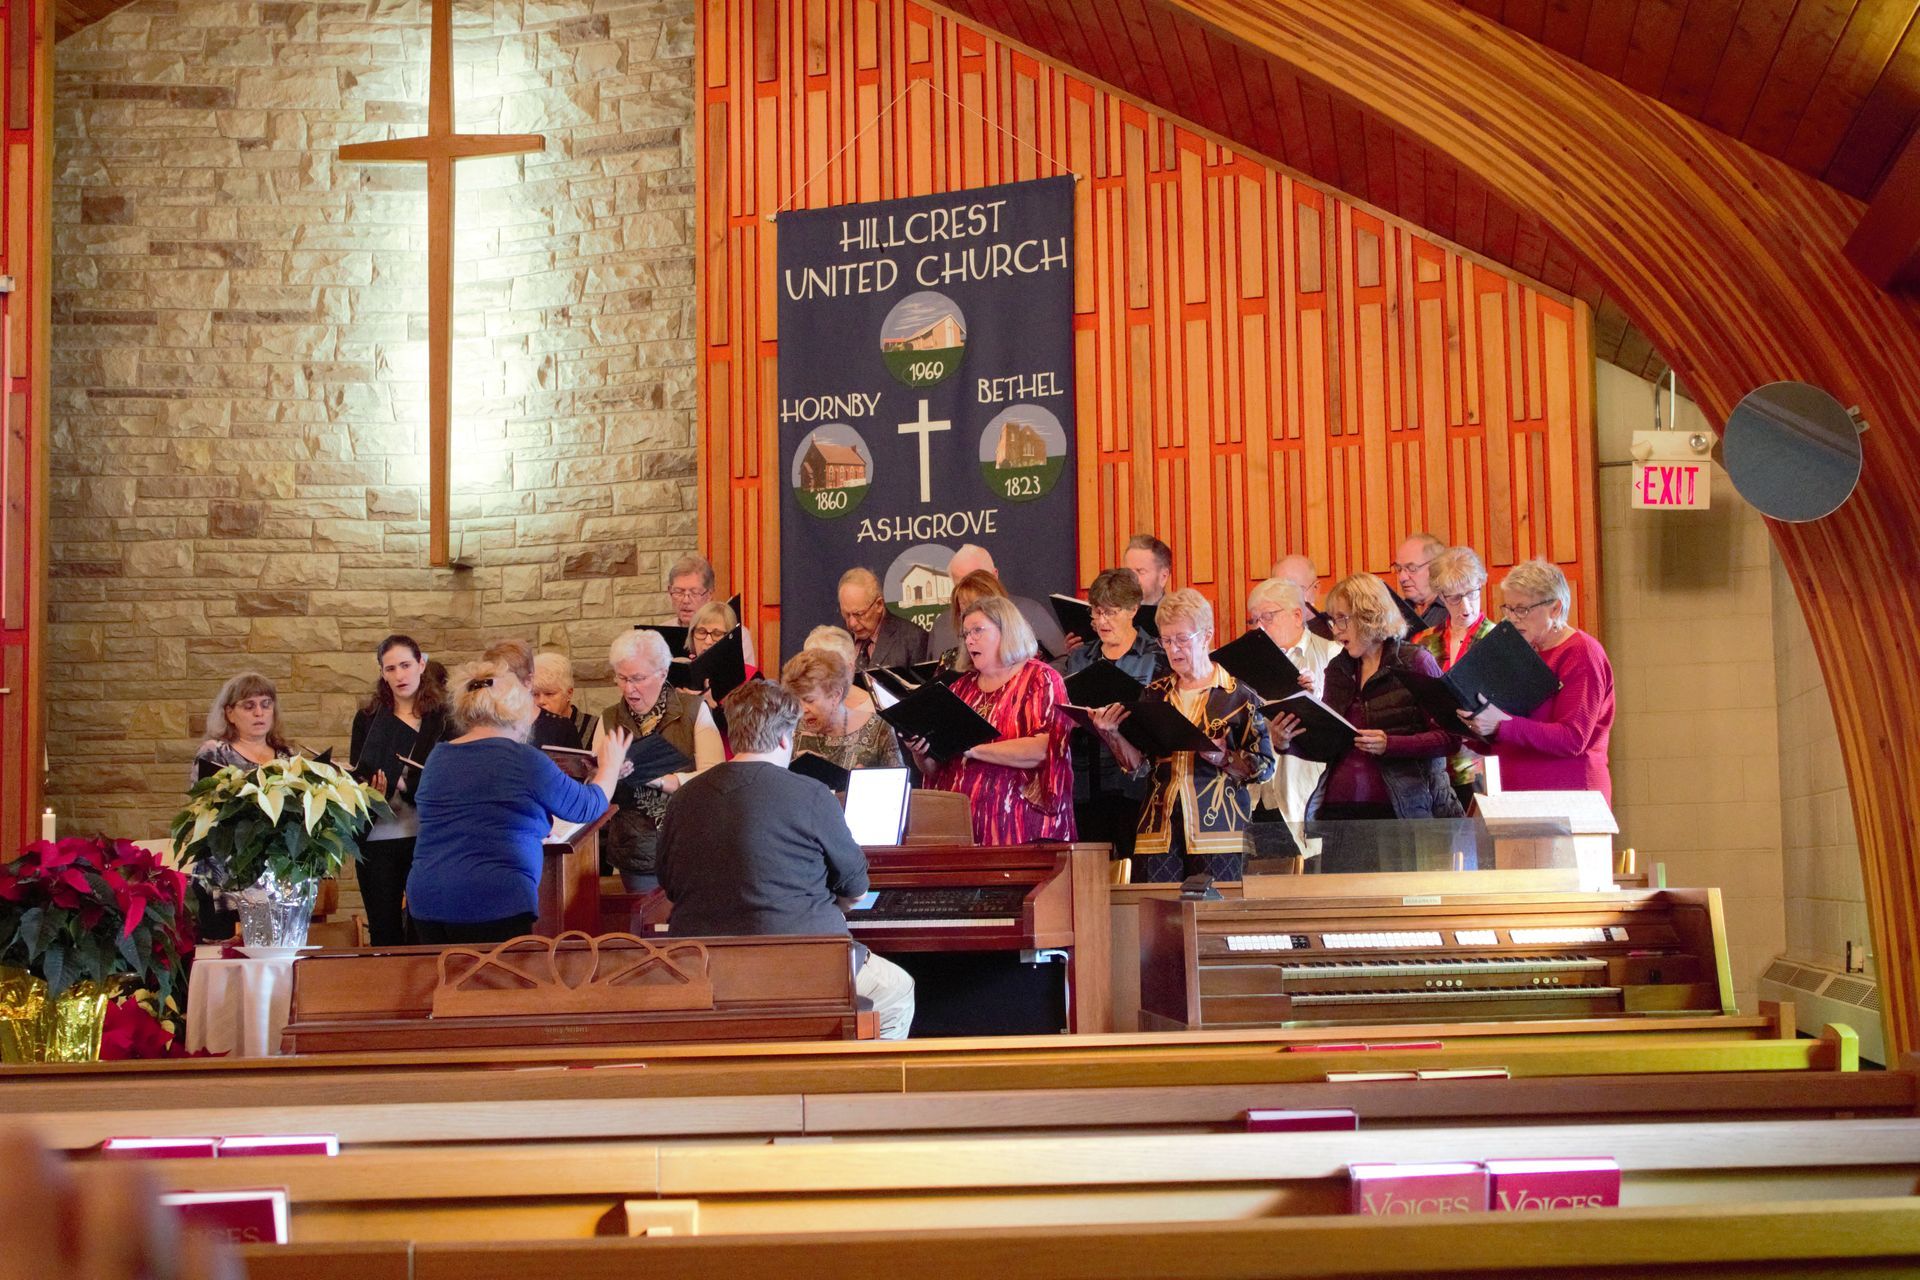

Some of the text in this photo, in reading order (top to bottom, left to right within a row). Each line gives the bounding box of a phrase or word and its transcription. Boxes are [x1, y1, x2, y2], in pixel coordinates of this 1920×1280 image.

[839, 200, 1007, 252] HILLCREST
[785, 236, 1068, 300] UNITED CHURCH
[909, 361, 944, 381] 1969
[977, 371, 1064, 403] BETHEL
[780, 392, 882, 423] HORNBY
[815, 491, 848, 511] 1860
[1004, 475, 1041, 497] 1823
[1643, 466, 1699, 505] EXIT
[857, 508, 998, 543] ASHGROVE
